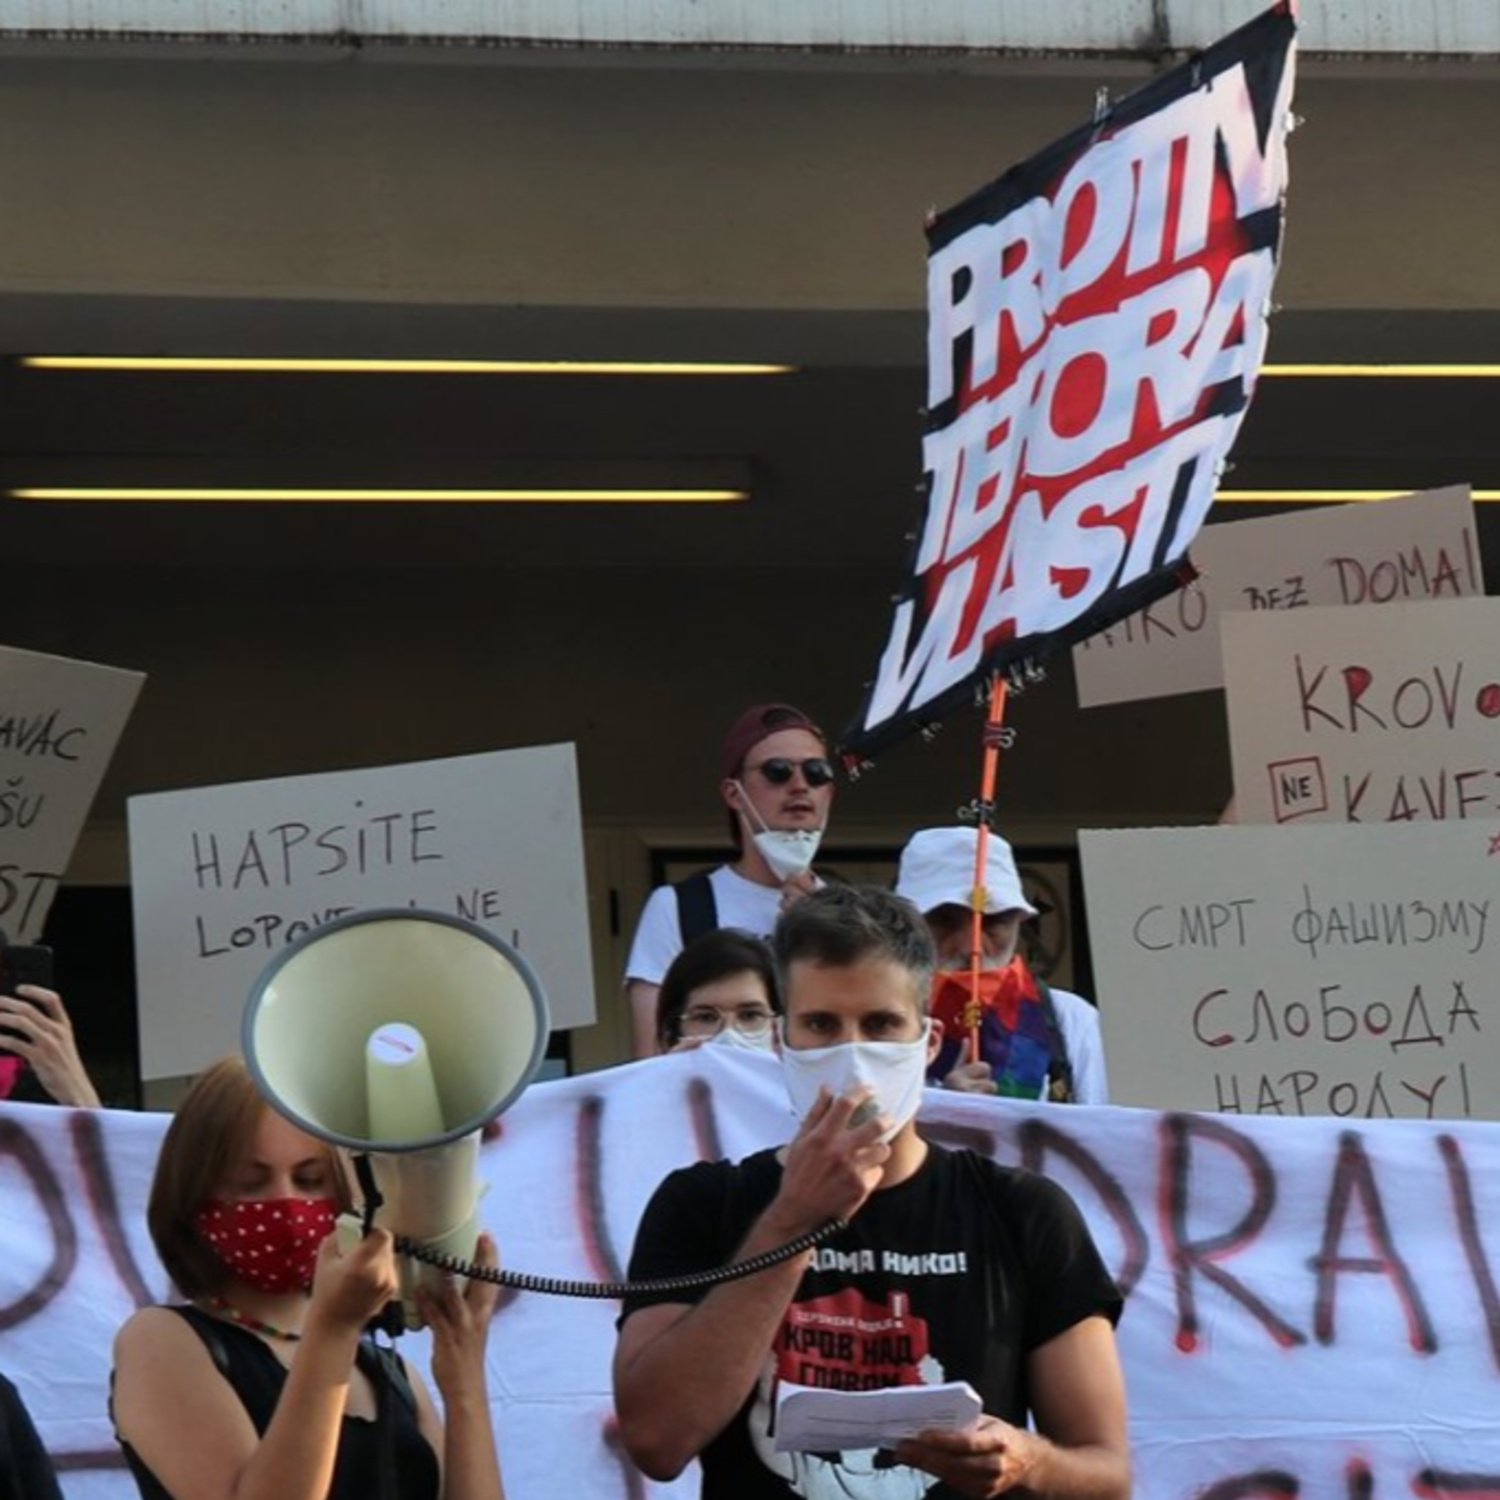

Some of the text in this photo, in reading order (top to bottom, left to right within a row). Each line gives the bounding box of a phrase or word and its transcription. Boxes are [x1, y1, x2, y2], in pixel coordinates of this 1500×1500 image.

[1281, 775, 1313, 803] NE
[1133, 899, 1255, 950] СМРТ
[1192, 980, 1480, 1055] СЛОБОДА
